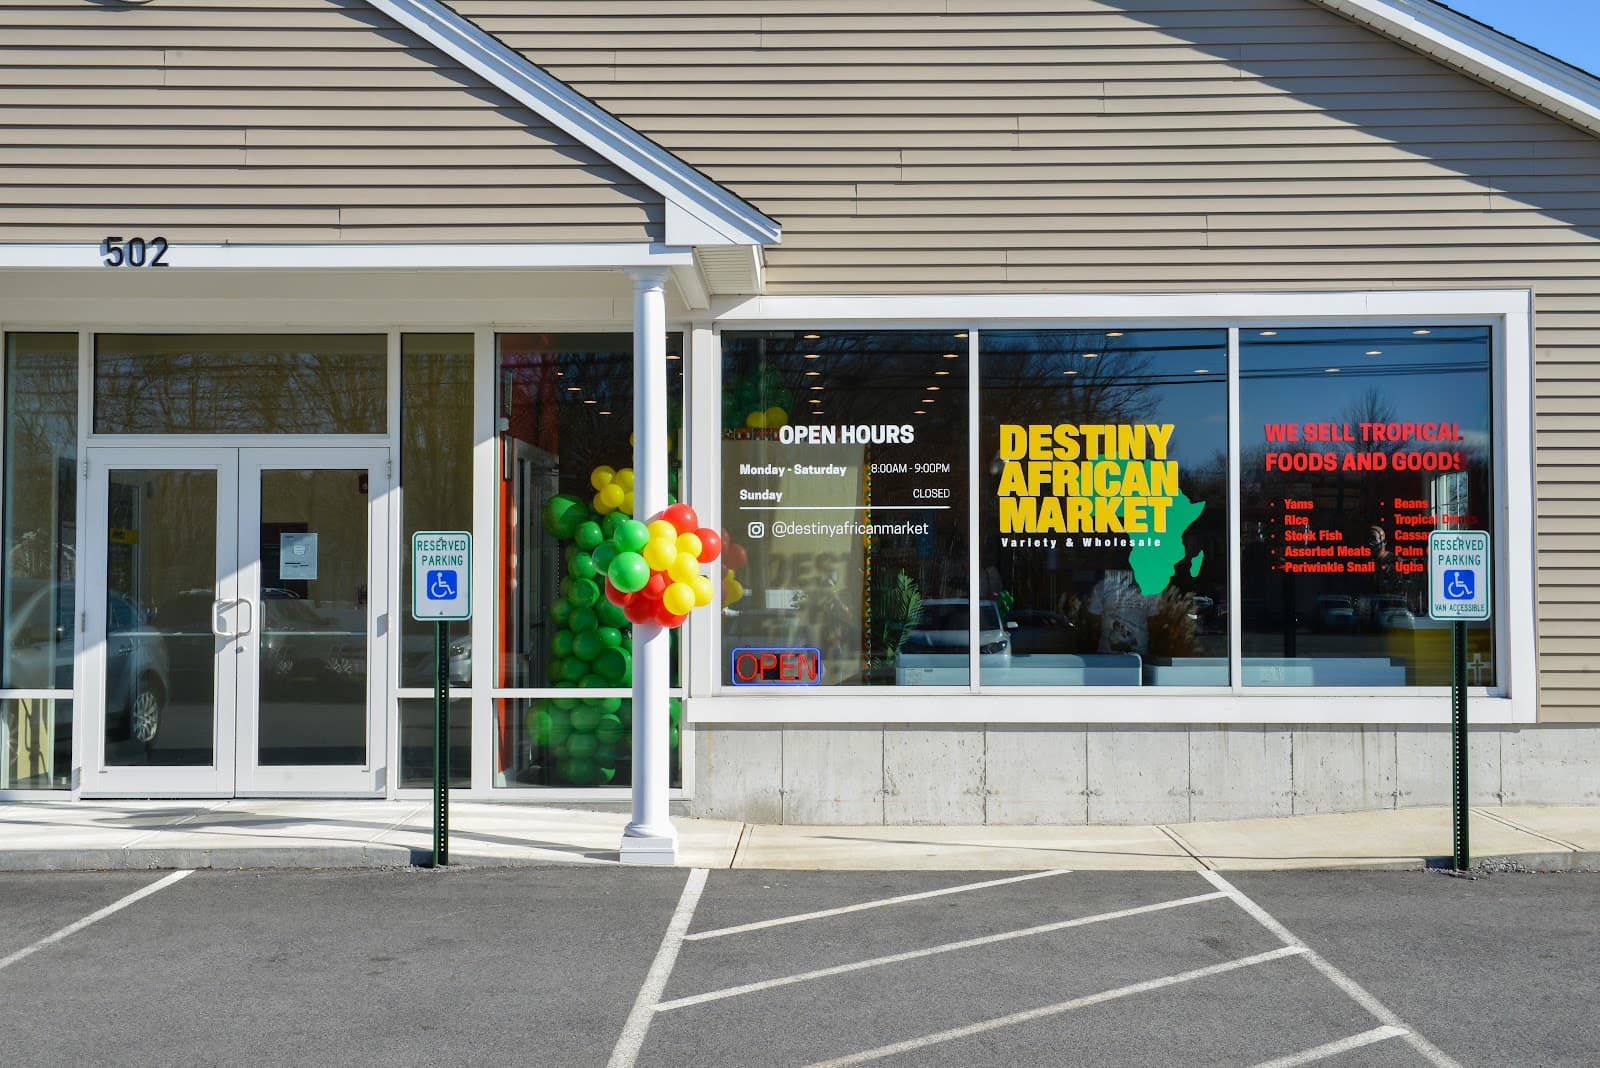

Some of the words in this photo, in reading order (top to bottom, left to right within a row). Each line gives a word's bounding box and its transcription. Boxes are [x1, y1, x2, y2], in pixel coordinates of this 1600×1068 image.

[102, 236, 169, 267] 502
[779, 425, 836, 445] OPEN
[842, 425, 914, 444] HOURS
[1265, 423, 1299, 442] WE
[1304, 423, 1355, 442] SELL
[1360, 422, 1464, 441] TROPICAL
[999, 424, 1175, 460] DESTINY
[1265, 452, 1337, 471] FOODS
[1342, 452, 1386, 471] AND
[1392, 451, 1467, 471] GOODS
[739, 464, 785, 477] Monday
[794, 464, 847, 477] Saturday
[871, 463, 907, 473] 8:00AM
[914, 463, 950, 473] 9:00PM
[997, 460, 1179, 496] AFRICAN
[740, 489, 783, 502] Sunday
[913, 488, 950, 498] CLOSED
[1284, 499, 1314, 510] Yams
[1394, 498, 1429, 509] Beans
[999, 497, 1173, 533] MARKET
[1285, 515, 1309, 526] Rice
[1394, 514, 1438, 526] Tropical
[772, 521, 929, 537] @destinyafricanmarket
[1285, 530, 1316, 541] Stock
[1320, 530, 1343, 541] Fish
[1395, 530, 1429, 541] Cassa
[417, 540, 466, 551] RESERVED
[1001, 538, 1057, 549] Variety
[1065, 538, 1074, 548] &
[1083, 538, 1161, 548] Wholesale
[1433, 540, 1484, 551] RESERVED
[1284, 546, 1334, 557] Assorted
[1337, 546, 1372, 557] Meats
[1395, 546, 1424, 557] Palm
[421, 555, 463, 566] PARKING
[1438, 555, 1481, 566] PARKING
[1284, 562, 1345, 573] Periwinkle
[1346, 562, 1375, 573] Snail
[1395, 562, 1424, 575] Ugba
[1434, 604, 1447, 612] VAN
[1449, 603, 1485, 612] ACCESSIBLE
[735, 653, 818, 681] OPEN
